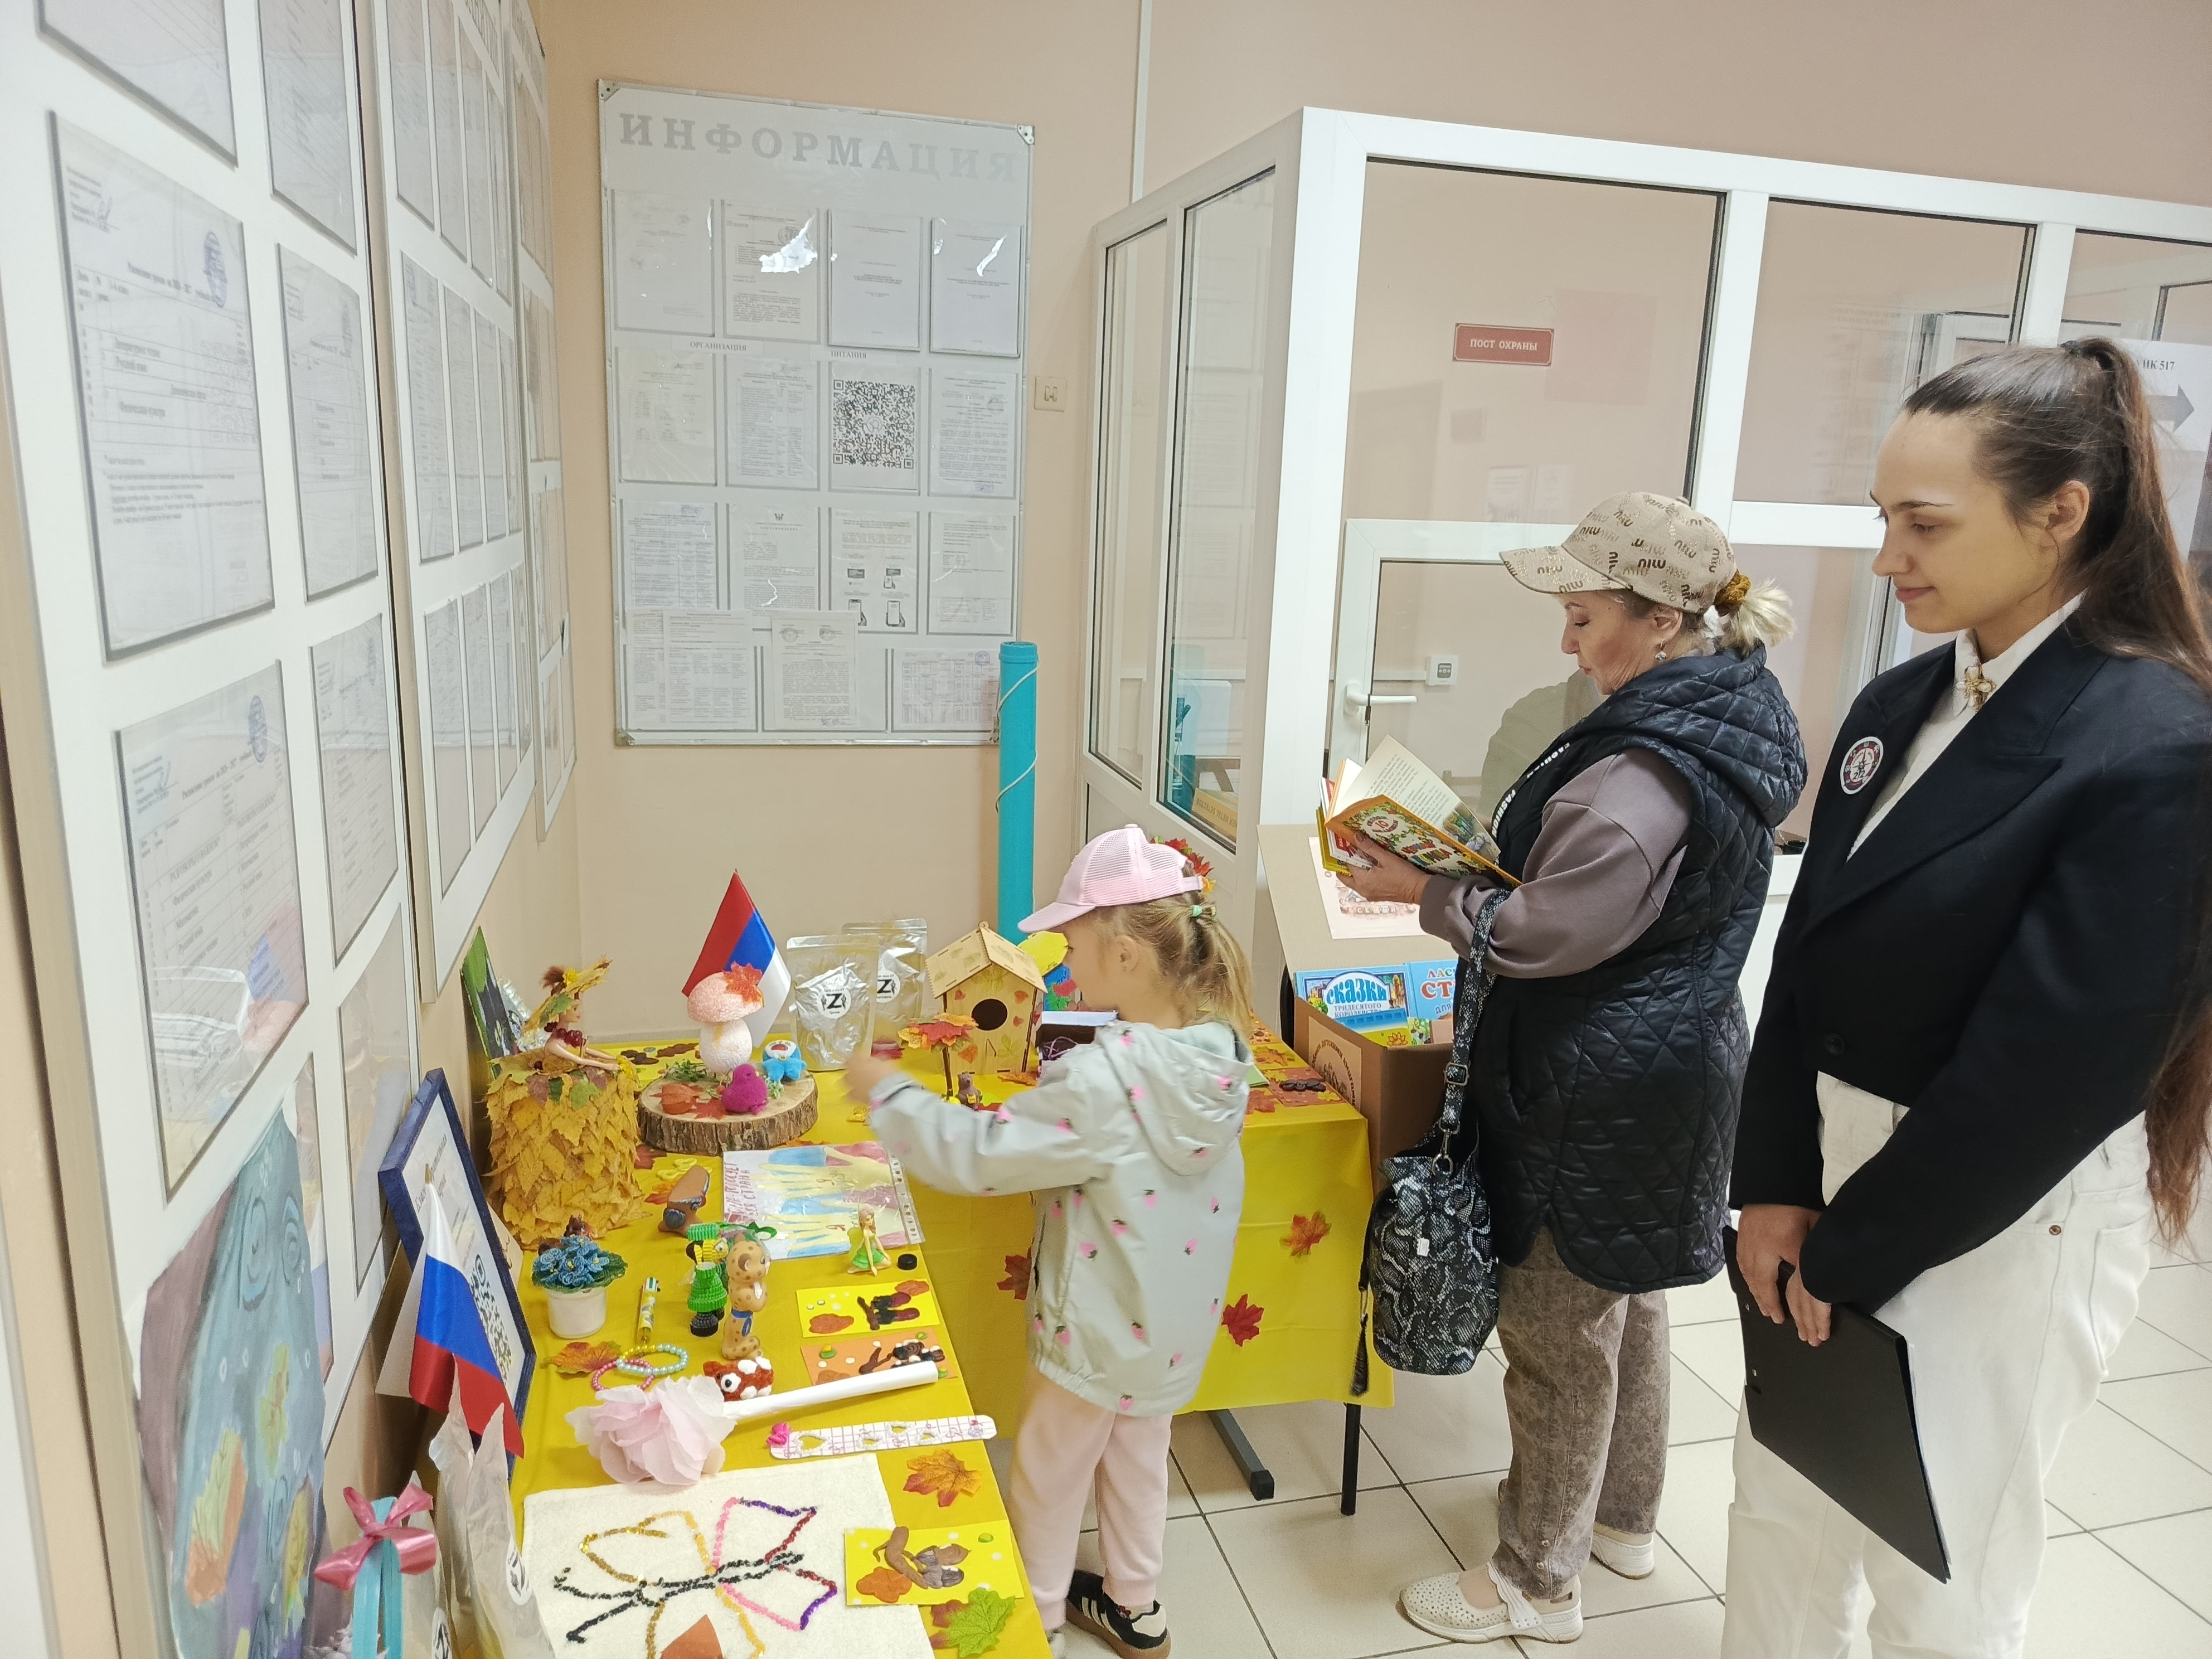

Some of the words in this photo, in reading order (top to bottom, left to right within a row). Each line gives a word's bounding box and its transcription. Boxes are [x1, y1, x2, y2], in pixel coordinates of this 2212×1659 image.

[619, 113, 1017, 182] ИНФОРМАЦИЯ
[690, 341, 747, 352] ОРГАНИЗАЦИЯ
[831, 351, 867, 360] ПИТАНИЯ
[1470, 339, 1495, 348] ПОСТ
[1498, 341, 1537, 351] ОХРАНЫ
[2159, 360, 2175, 371] 517
[1491, 789, 1516, 839] FASHION
[1421, 981, 1456, 1000] СТ
[826, 993, 842, 1009] Z
[1334, 1002, 1381, 1011] ТРИДЕСЯТОГО
[1434, 1002, 1452, 1015] ДЛЯ
